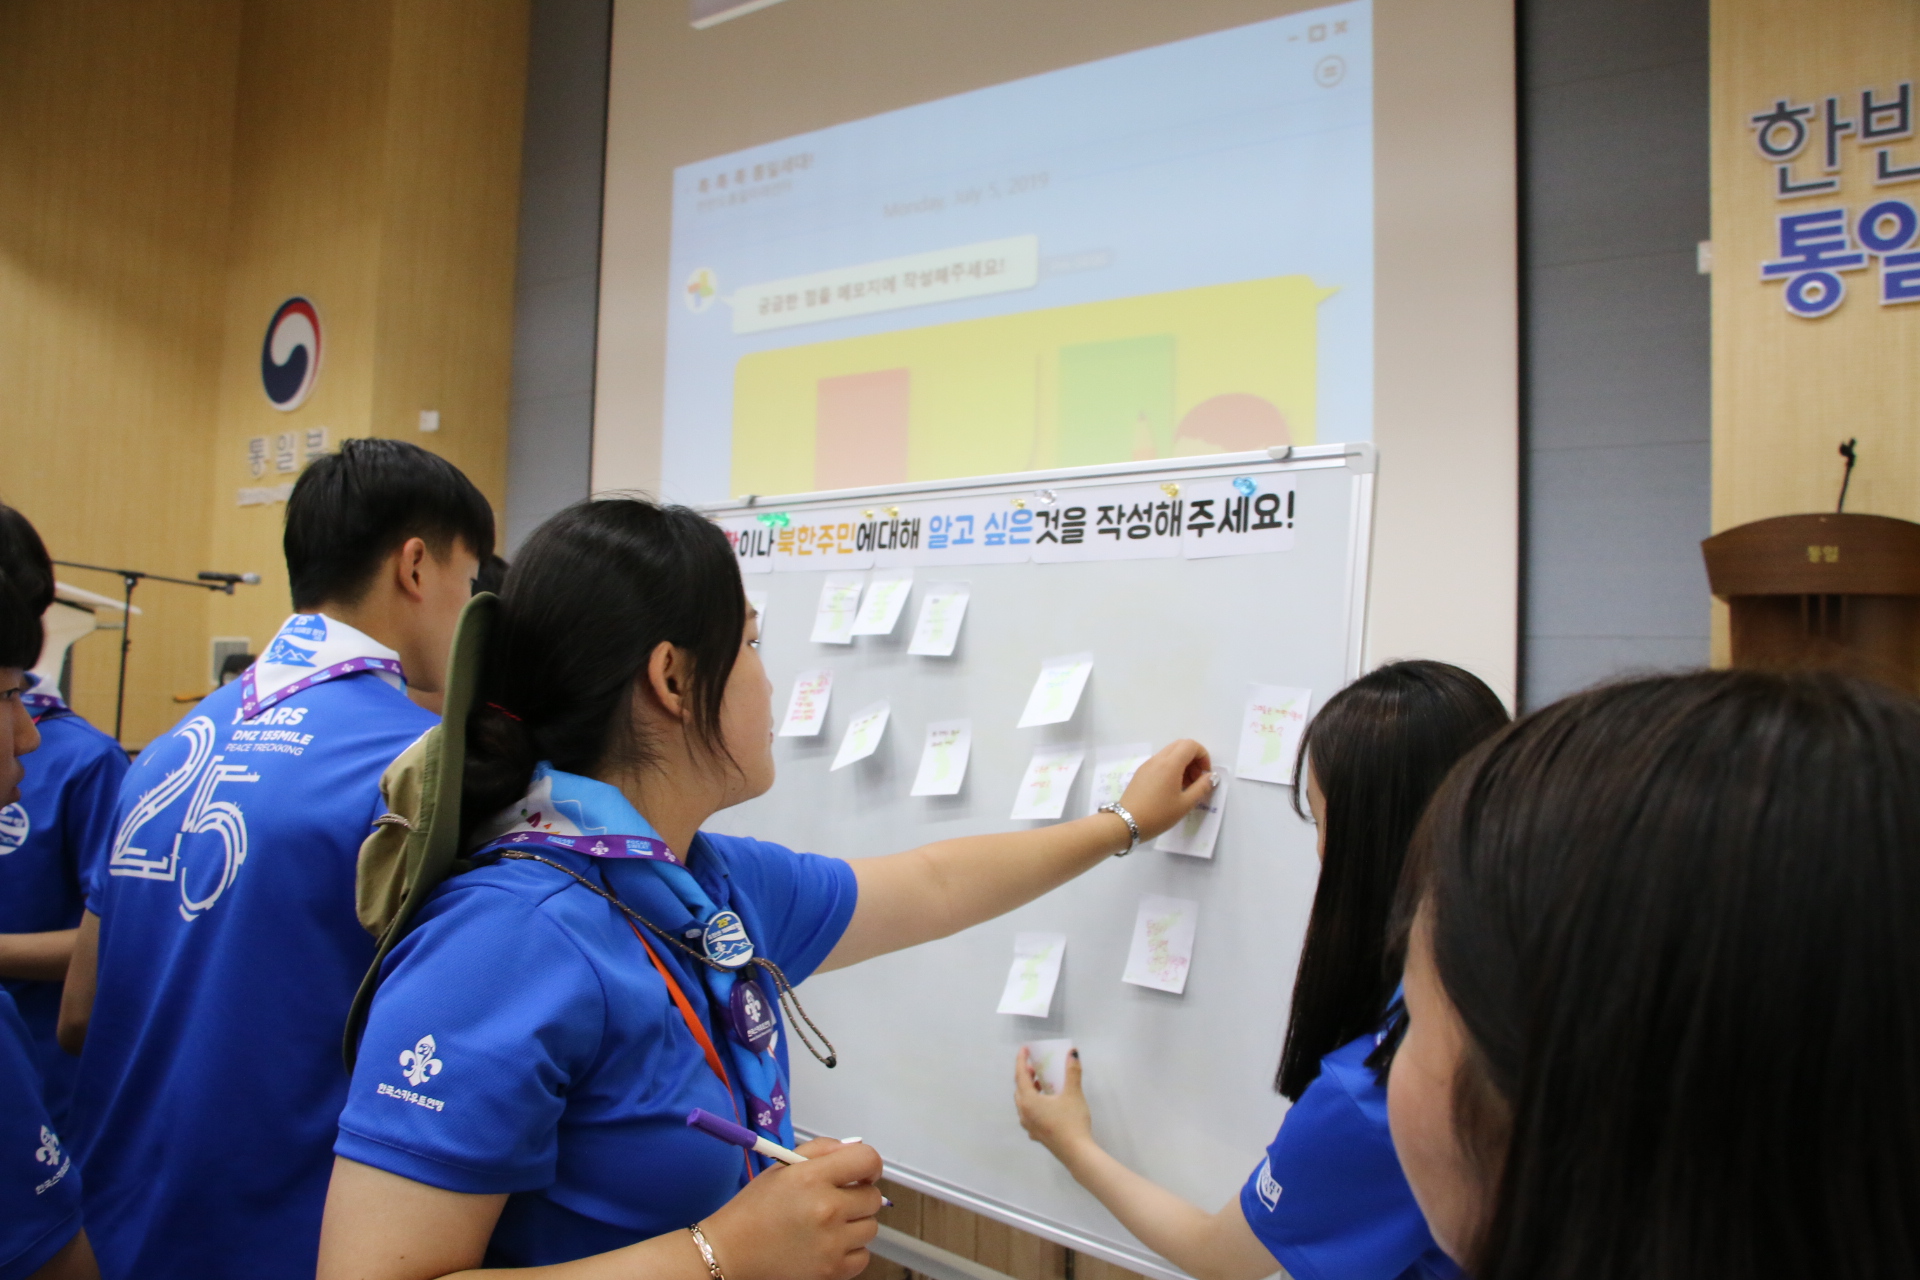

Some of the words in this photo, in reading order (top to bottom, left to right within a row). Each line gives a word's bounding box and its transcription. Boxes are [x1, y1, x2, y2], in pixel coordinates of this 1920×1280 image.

[903, 258, 1005, 289] 작성해주세요!
[928, 514, 975, 550] 알고
[1096, 490, 1295, 541] 작성해주세요!
[225, 743, 253, 752] PEACE
[252, 743, 304, 756] TRECKKING
[232, 729, 261, 741] DMZ
[260, 729, 315, 746] 155MILE
[110, 715, 261, 922] 25
[377, 1083, 445, 1112] 한국스카우트연맹
